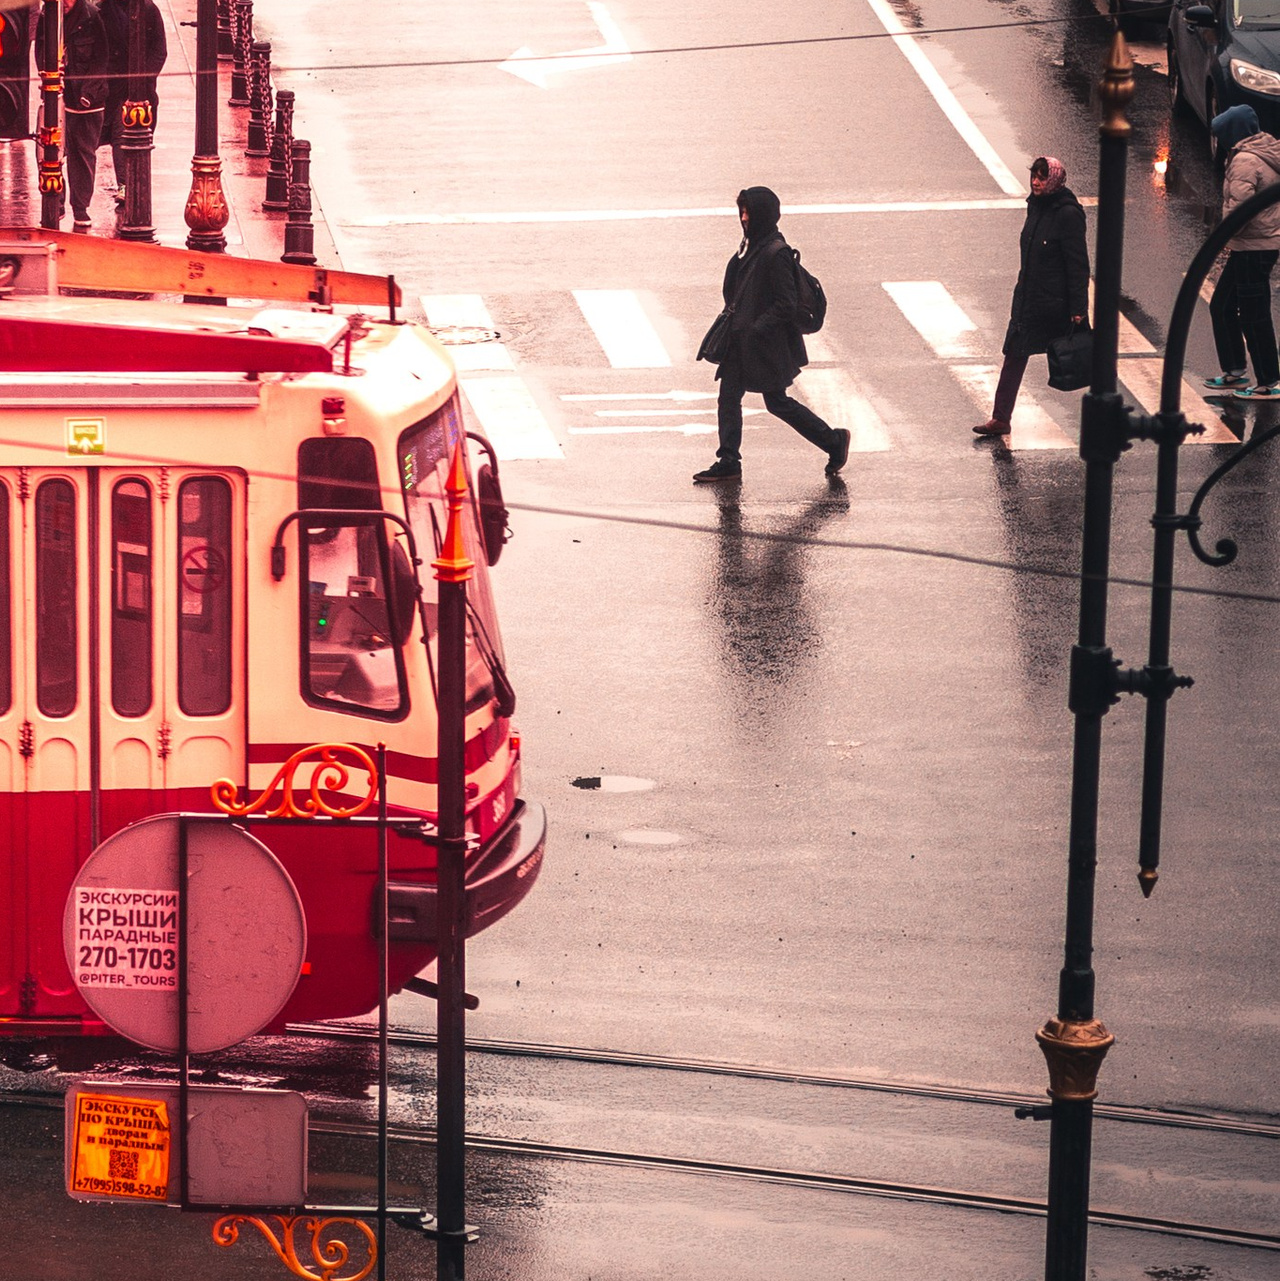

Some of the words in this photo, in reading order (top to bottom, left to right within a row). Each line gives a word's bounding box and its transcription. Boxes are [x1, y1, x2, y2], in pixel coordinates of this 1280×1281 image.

[80, 892, 177, 907] ЭКСКУРСИИ
[79, 908, 176, 929] КРЫШИ
[79, 928, 176, 944] ПАРАДНЫЕ
[79, 945, 176, 970] 270-1703
[79, 973, 176, 987] @PITER_TOURS
[81, 1113, 102, 1123] ПО
[105, 1115, 170, 1131] КРЫША
[104, 1128, 148, 1139] дворам
[99, 1137, 164, 1151] парадным
[76, 1177, 167, 1197] +7(995)598-52-87
